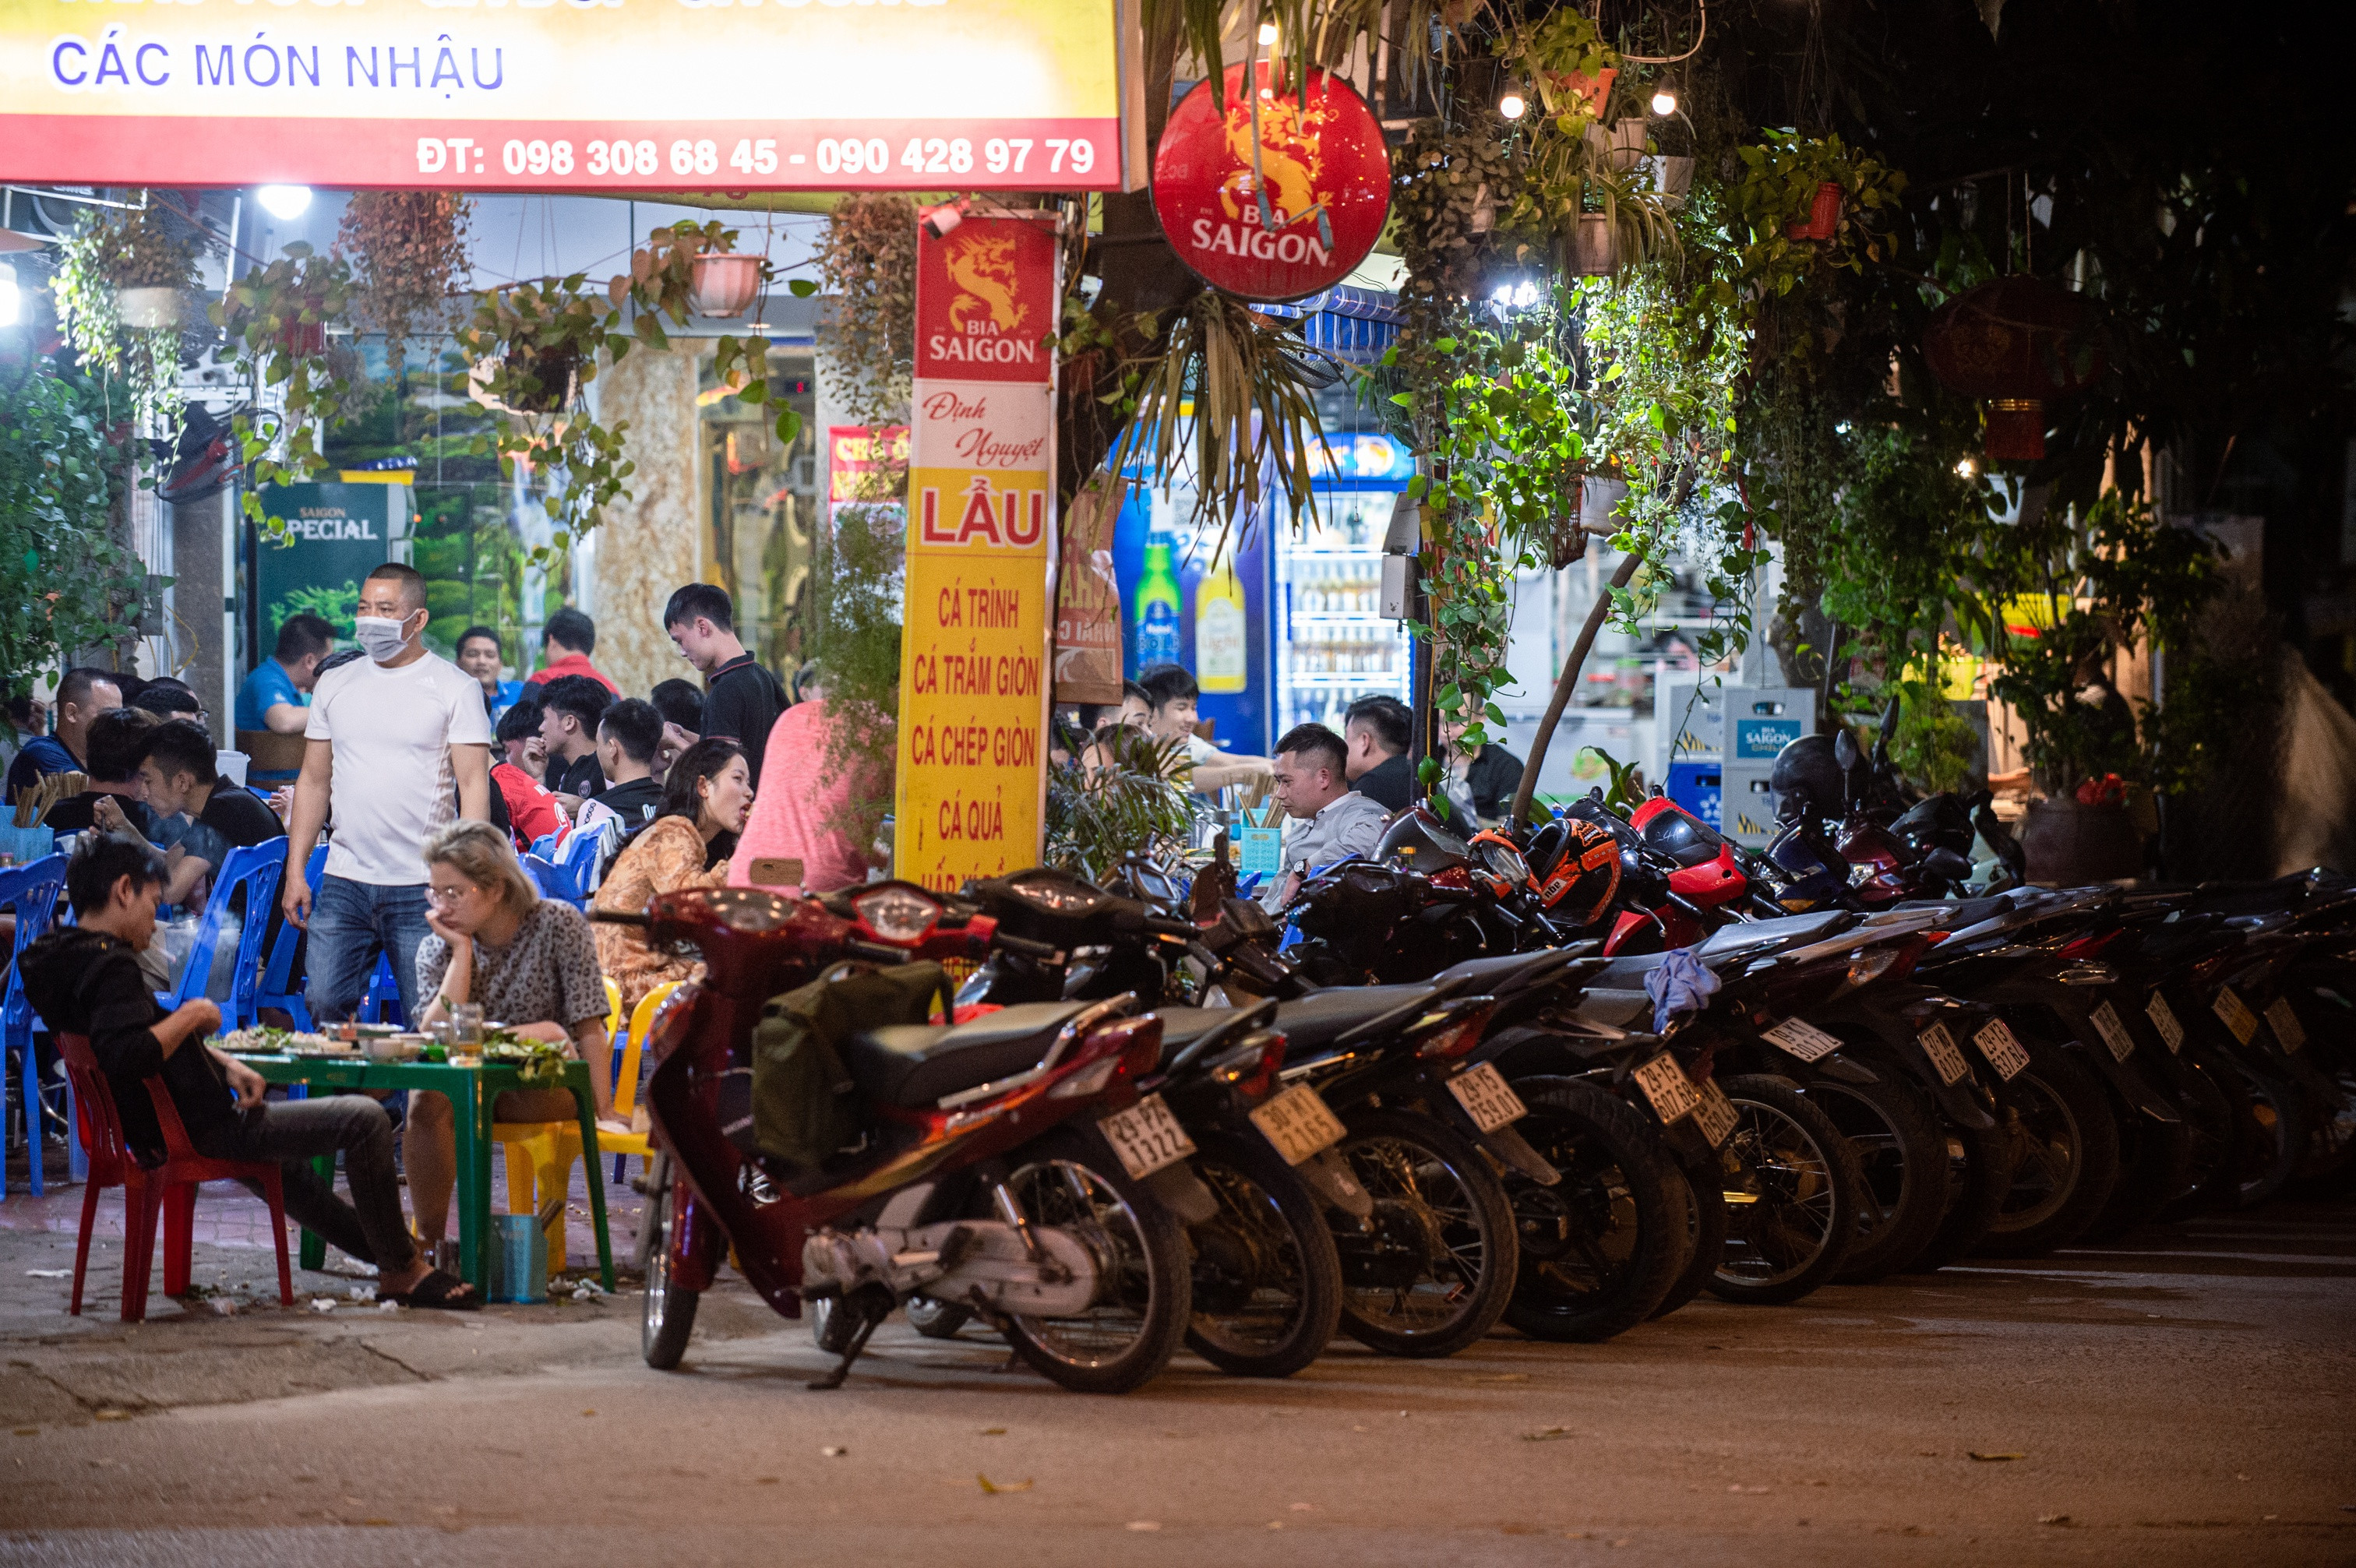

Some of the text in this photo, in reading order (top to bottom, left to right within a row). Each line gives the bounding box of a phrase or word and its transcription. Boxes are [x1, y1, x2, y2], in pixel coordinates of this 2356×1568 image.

[53, 30, 503, 99] CÁC MÓN NHẬU
[416, 138, 485, 174] ĐT:
[503, 139, 573, 175] 098
[587, 140, 659, 174] 308
[669, 140, 719, 174] 68
[730, 139, 778, 174] 45
[816, 139, 889, 174] 090
[901, 139, 974, 173] 428
[986, 139, 1033, 173] 97
[1045, 139, 1095, 174] 79
[1243, 204, 1286, 227] BA
[1191, 218, 1331, 267] SAIGON
[966, 319, 1000, 337] BIA
[929, 336, 1035, 364] SAIGON
[922, 391, 987, 422] Định
[270, 518, 378, 541] PECIAL
[299, 507, 346, 519] SAIGON
[921, 476, 1044, 546] LẨU
[938, 577, 1019, 628] CÁ TRÌNH
[914, 637, 1039, 696] CÁ TRẮM GIÒN
[912, 714, 1035, 767] CÁ CHÉP GIÒN
[1745, 732, 1791, 745] SAIGON
[939, 785, 1003, 840] CÁ QUẢ
[1788, 1031, 1839, 1059] 301.72
[1977, 1020, 2009, 1055] 29-Y3
[1639, 1056, 1678, 1094] 29-Y5
[1938, 1048, 1965, 1082] 8175
[1991, 1041, 2027, 1080] 537.64
[1652, 1079, 1697, 1121] 607.68
[1127, 1126, 1184, 1169] 1322
